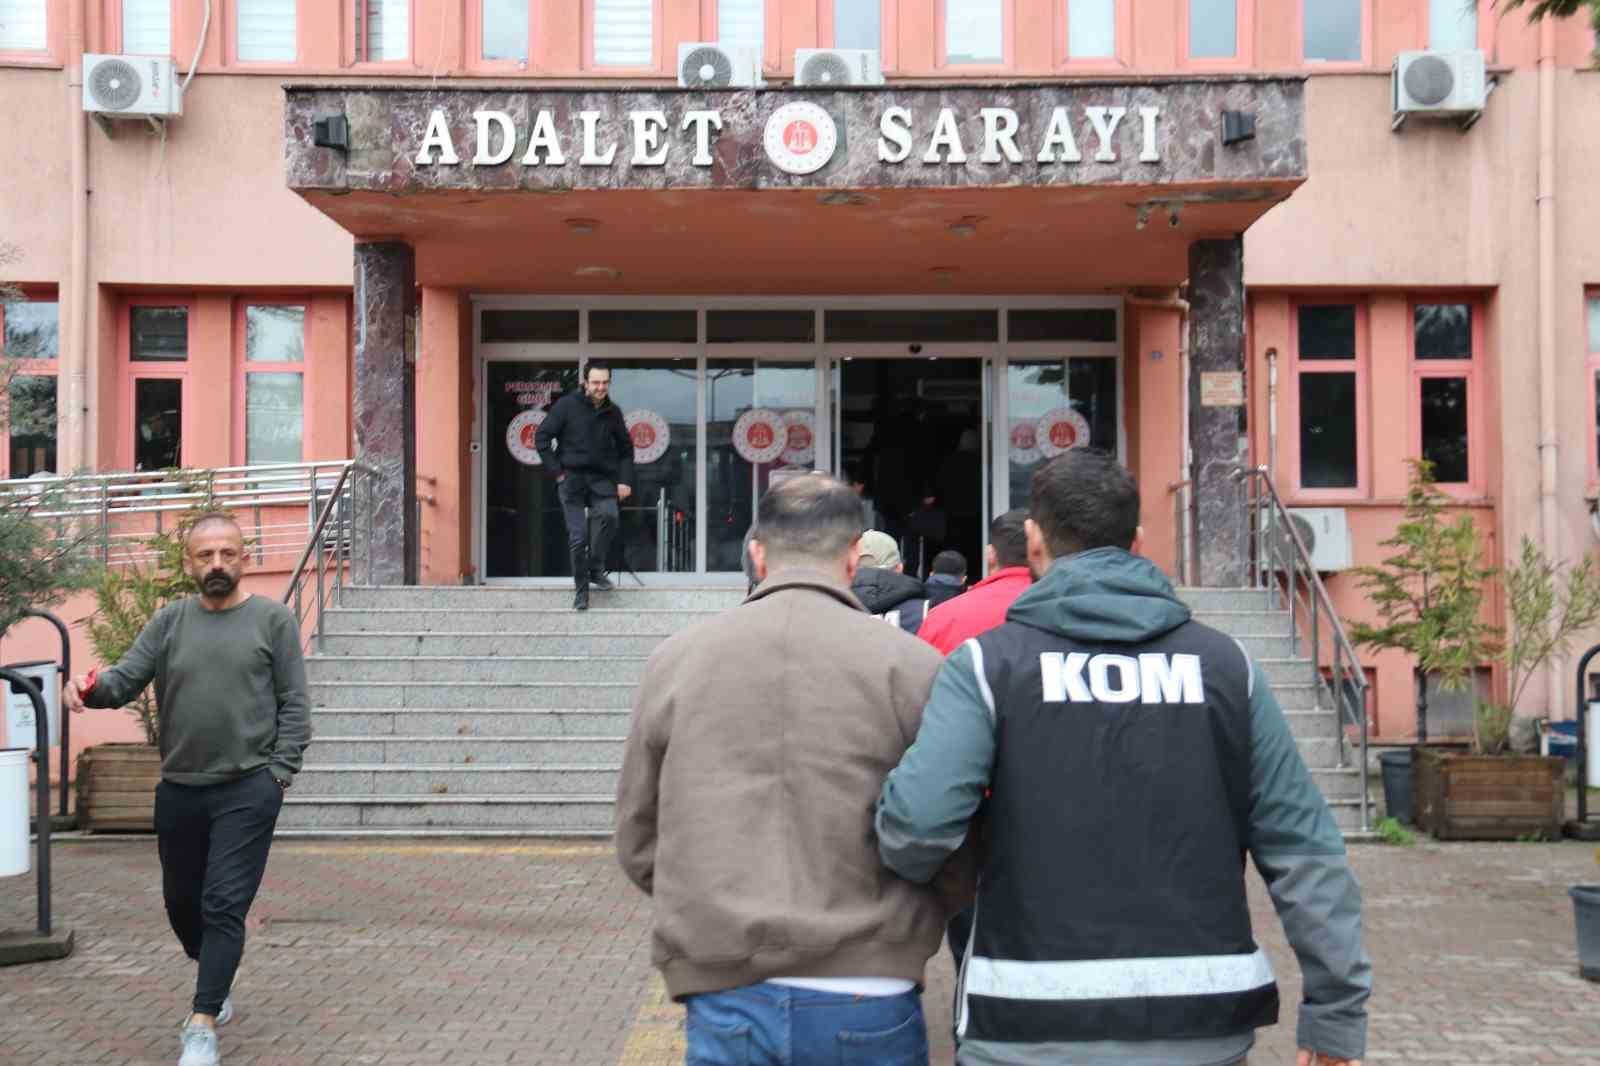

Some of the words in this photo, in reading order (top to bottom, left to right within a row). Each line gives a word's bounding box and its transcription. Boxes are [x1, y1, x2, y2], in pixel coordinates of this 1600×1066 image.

[414, 109, 723, 166] ADALET
[877, 106, 1161, 163] SARAYI
[1040, 652, 1204, 704] KOM
